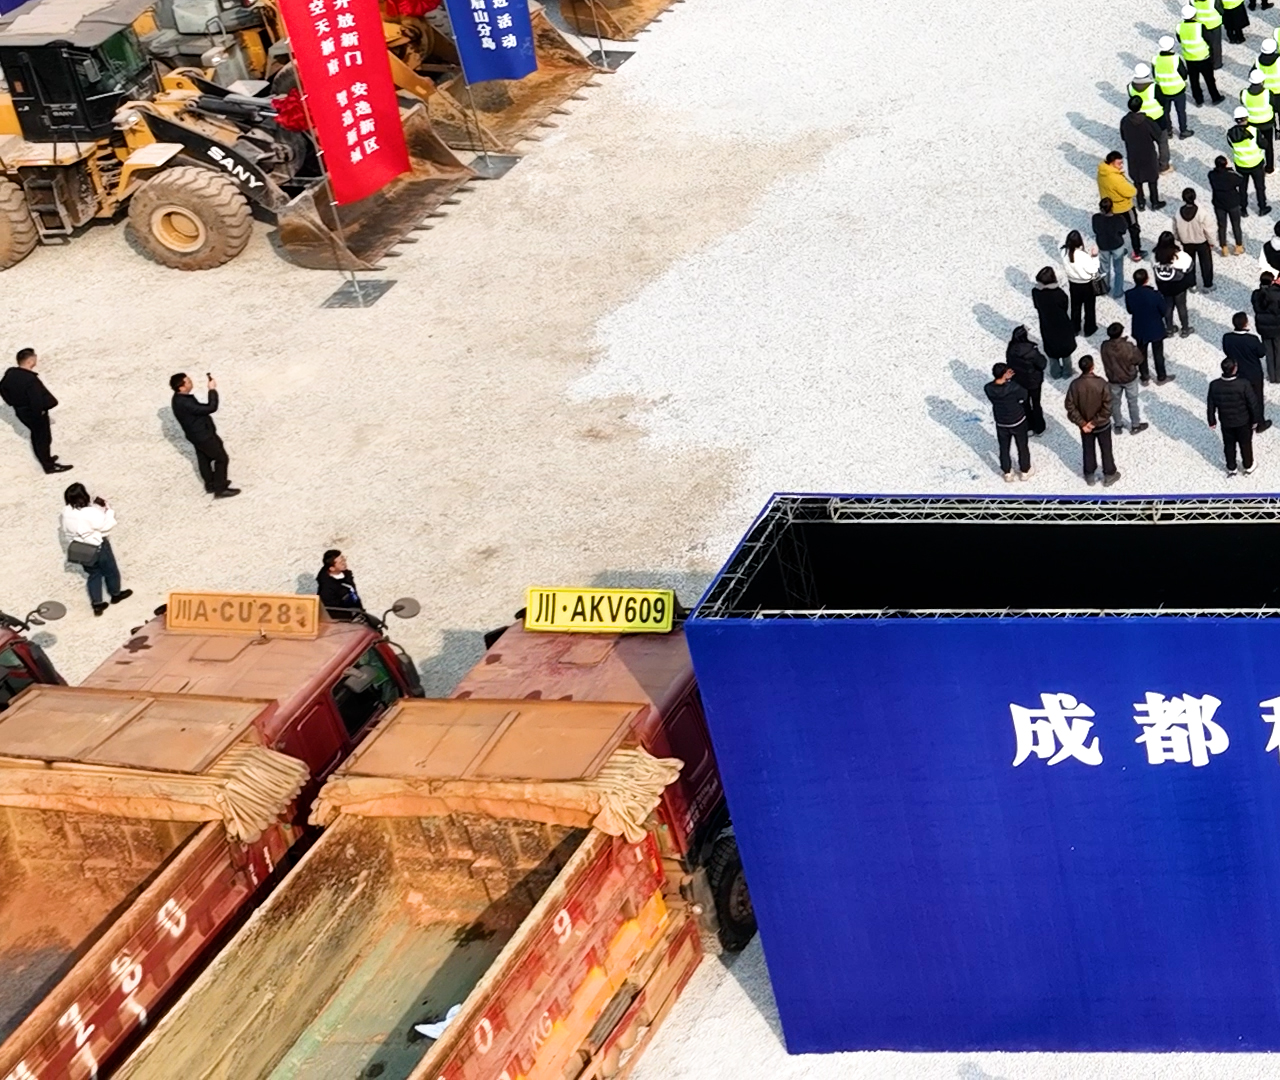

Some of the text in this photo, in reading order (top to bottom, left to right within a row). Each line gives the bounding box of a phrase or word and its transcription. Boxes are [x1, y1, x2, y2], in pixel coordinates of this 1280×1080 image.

[351, 81, 380, 156] 安逸新区
[206, 144, 264, 189] SANY
[535, 592, 666, 624] 川·AKV609
